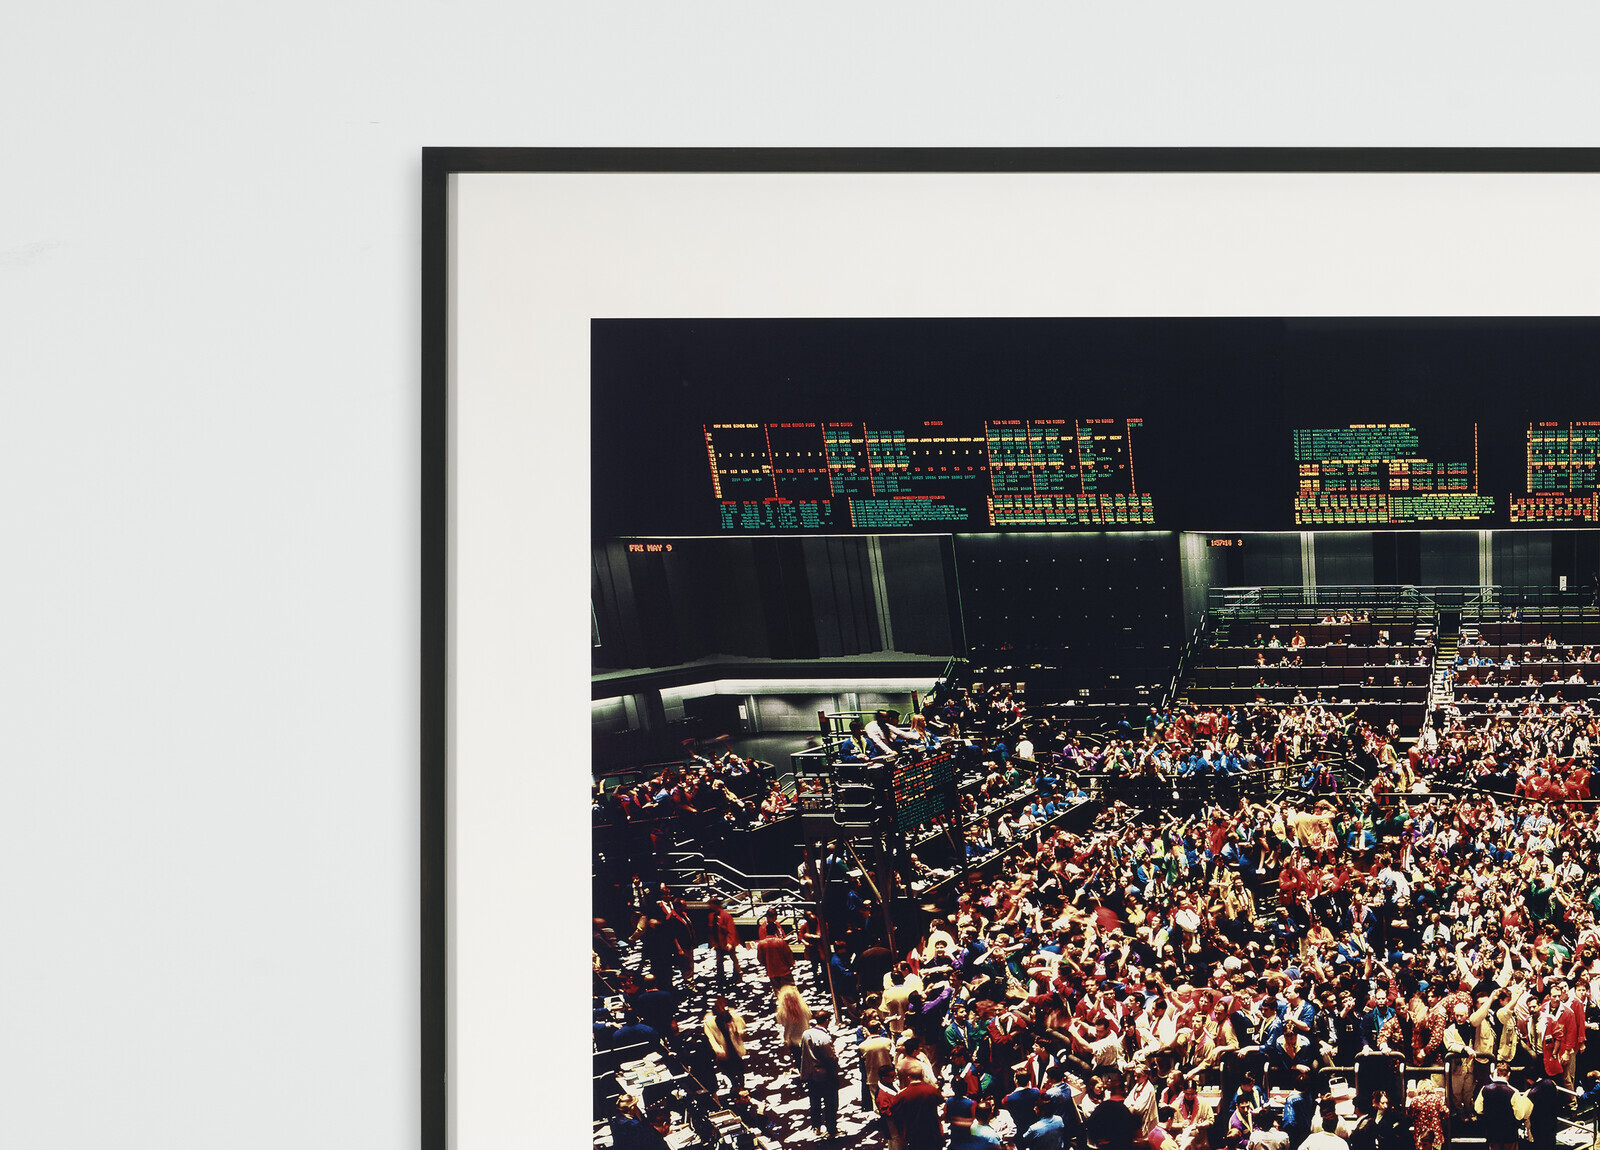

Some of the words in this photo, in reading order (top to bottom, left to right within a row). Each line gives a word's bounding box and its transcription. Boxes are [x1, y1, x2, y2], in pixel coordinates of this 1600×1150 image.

[1237, 539, 1243, 547] 3
[628, 544, 644, 552] FRI
[646, 544, 663, 552] MAY
[665, 543, 673, 552] 9
